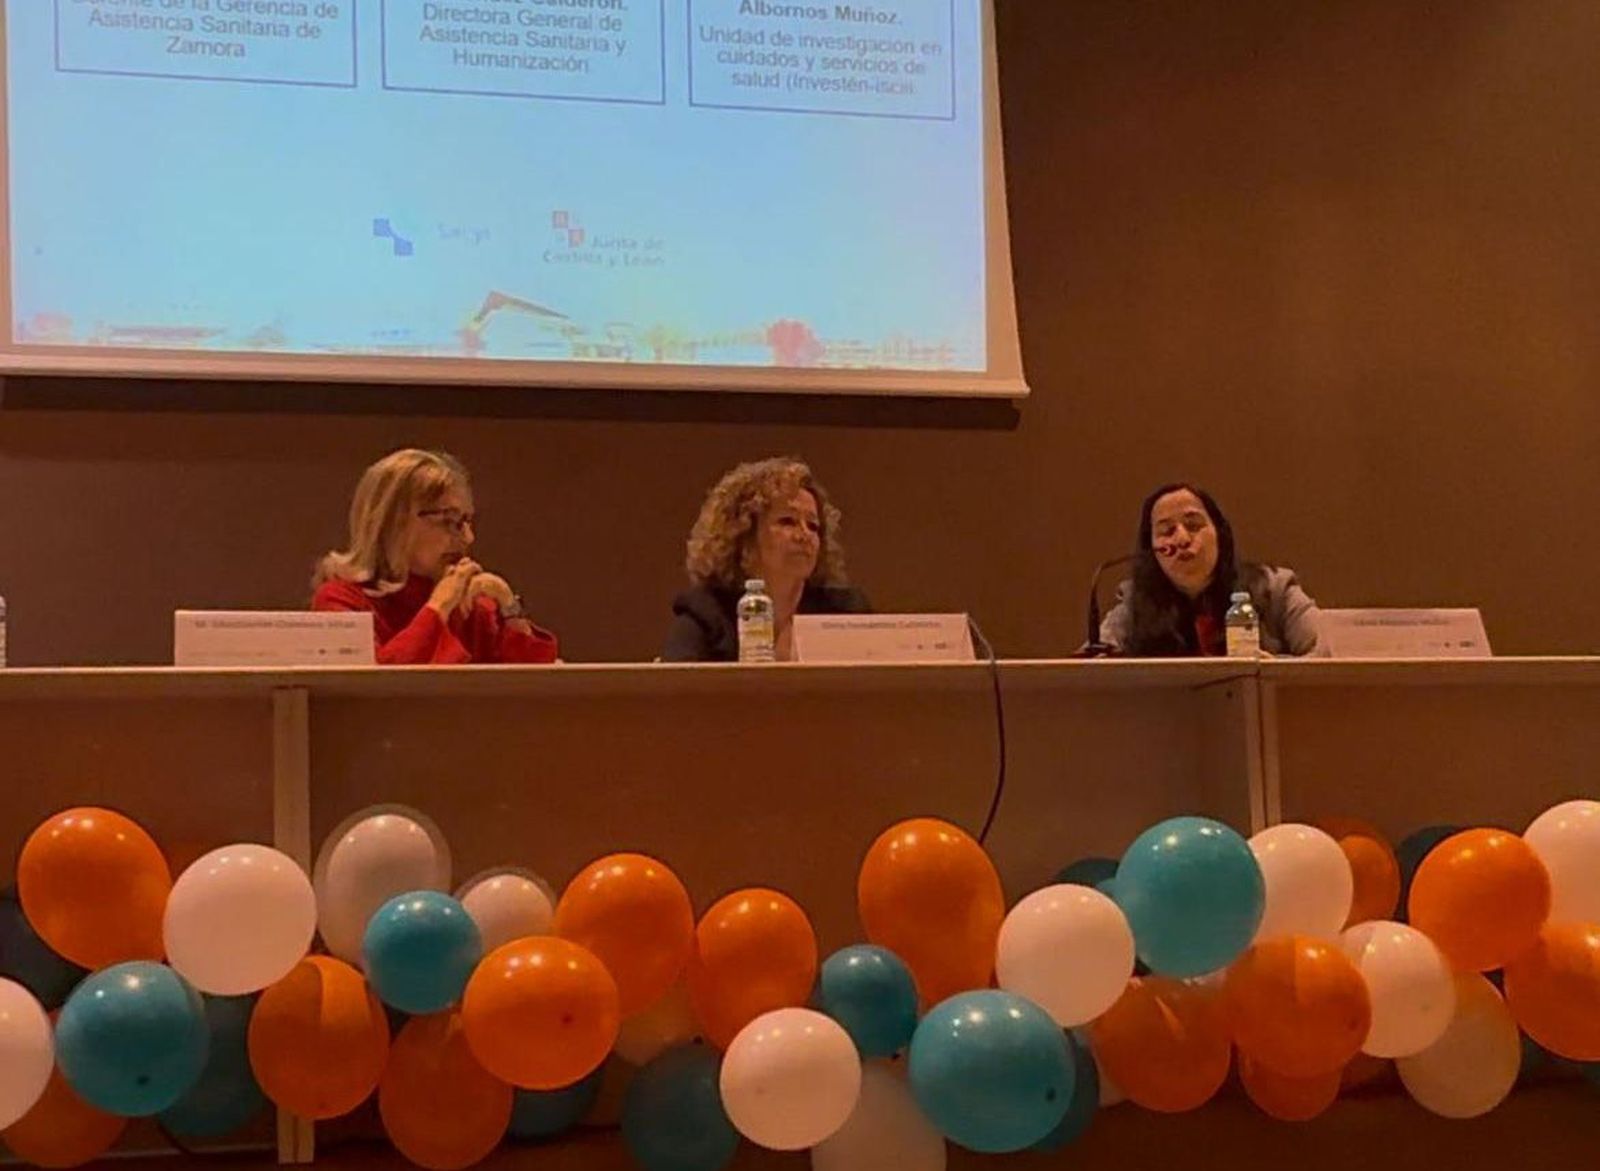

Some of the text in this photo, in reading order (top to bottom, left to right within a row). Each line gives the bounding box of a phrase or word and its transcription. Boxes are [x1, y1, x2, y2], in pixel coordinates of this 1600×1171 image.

[218, 0, 308, 16] Gerencia
[314, 2, 339, 19] de
[423, 3, 623, 32] Directora General de
[740, 0, 903, 25] Albornos Muñoz.
[89, 8, 321, 39] Asistencia Sanitaria de
[166, 36, 246, 58] Zamora
[419, 24, 627, 57] Asistencia Sanitaria y
[699, 26, 942, 57] Unidad de investigación en
[453, 48, 589, 73] Humanización
[717, 47, 927, 75] cuidados y servicios de
[732, 70, 780, 88] salud
